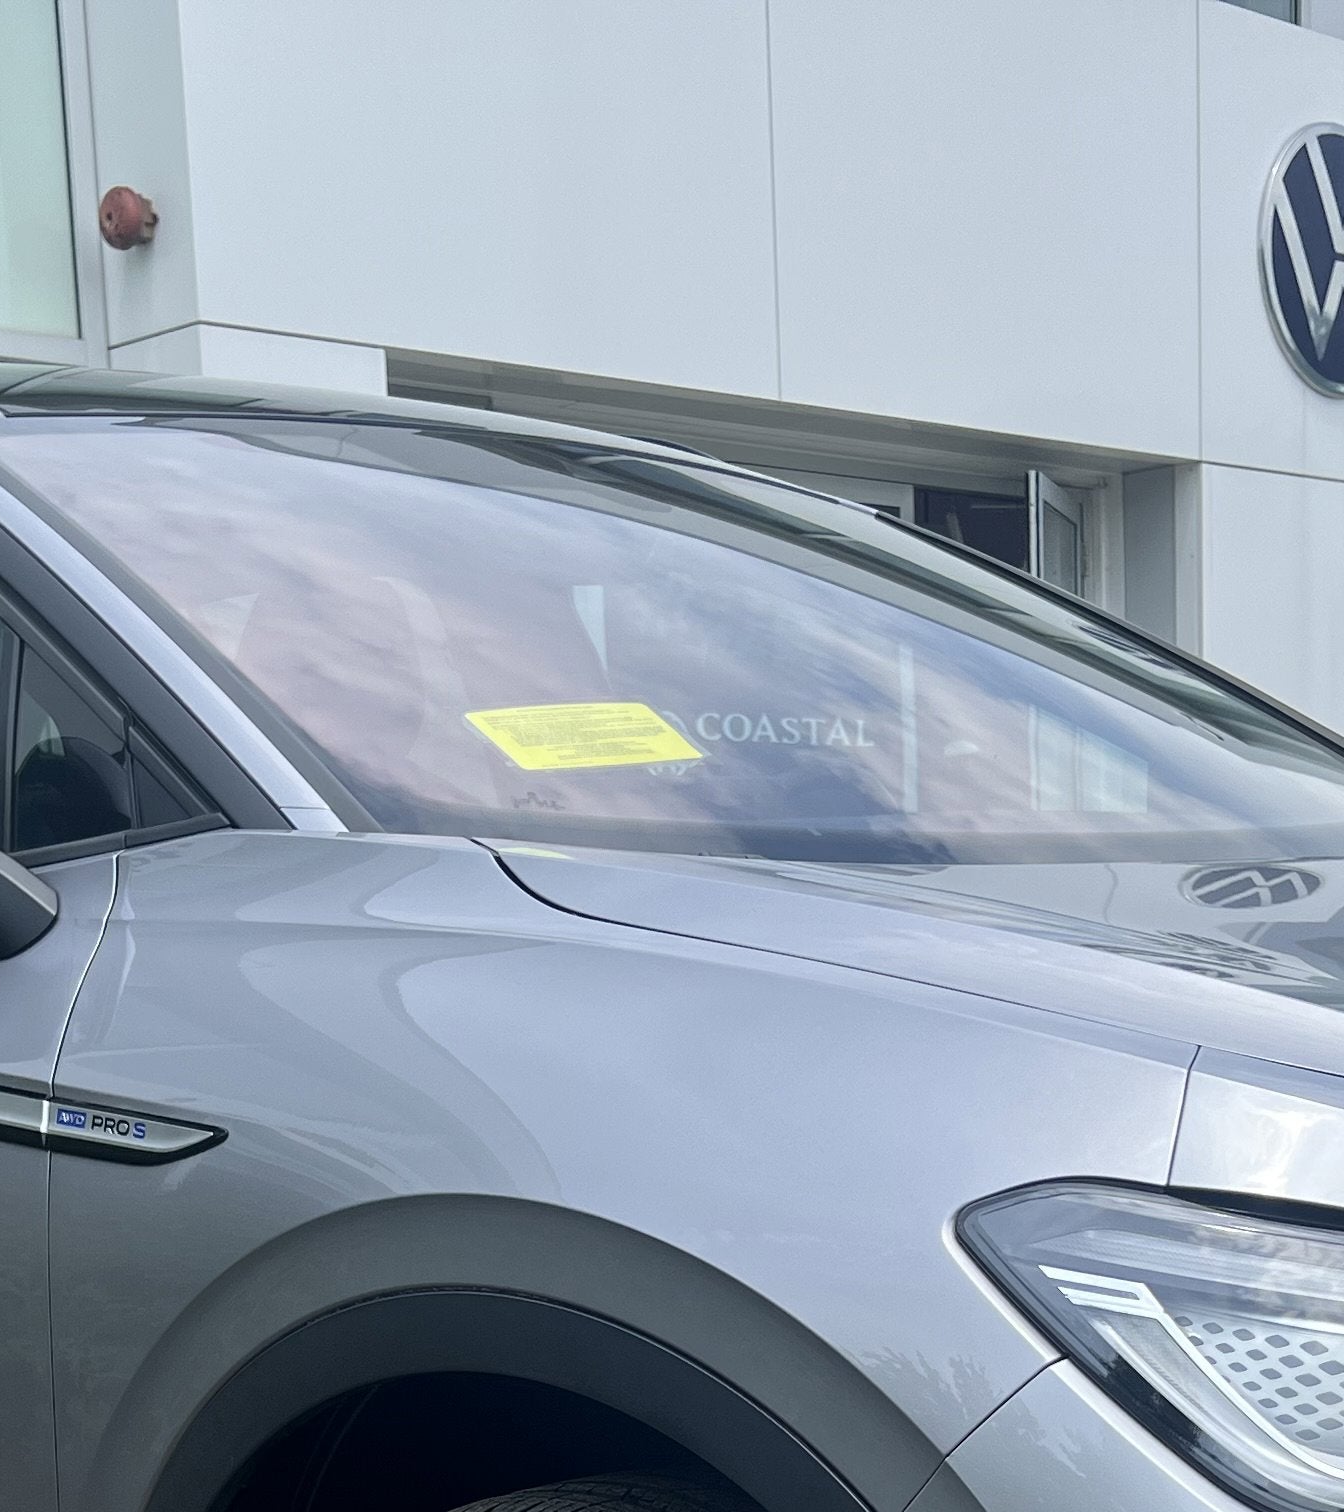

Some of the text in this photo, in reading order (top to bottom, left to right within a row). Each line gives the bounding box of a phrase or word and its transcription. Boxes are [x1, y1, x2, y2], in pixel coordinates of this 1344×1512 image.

[695, 712, 875, 747] COASTAL
[91, 1115, 130, 1136] PRO
[133, 1122, 146, 1138] S
